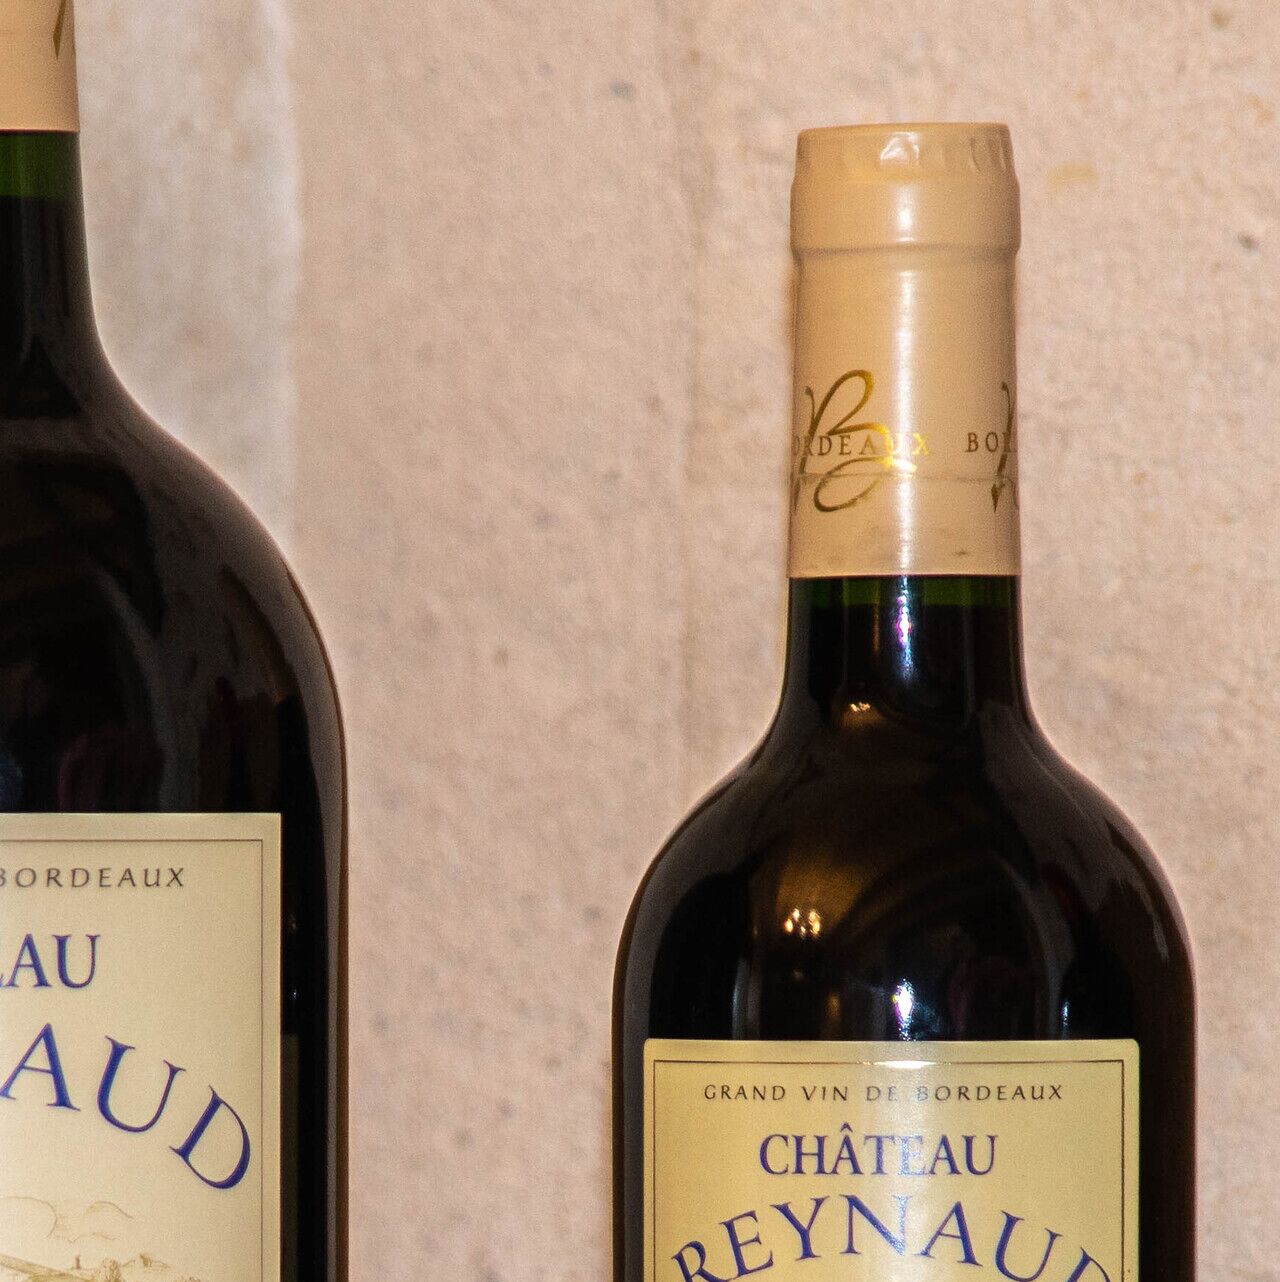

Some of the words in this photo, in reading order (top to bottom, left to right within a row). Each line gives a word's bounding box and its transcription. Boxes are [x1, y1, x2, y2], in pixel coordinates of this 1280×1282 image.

[704, 1084, 786, 1100] GRAND
[802, 1085, 848, 1101] VIN
[866, 1086, 898, 1101] DE
[917, 1085, 1063, 1101] BORDEAUX
[760, 1122, 998, 1176] CHÂTEAU
